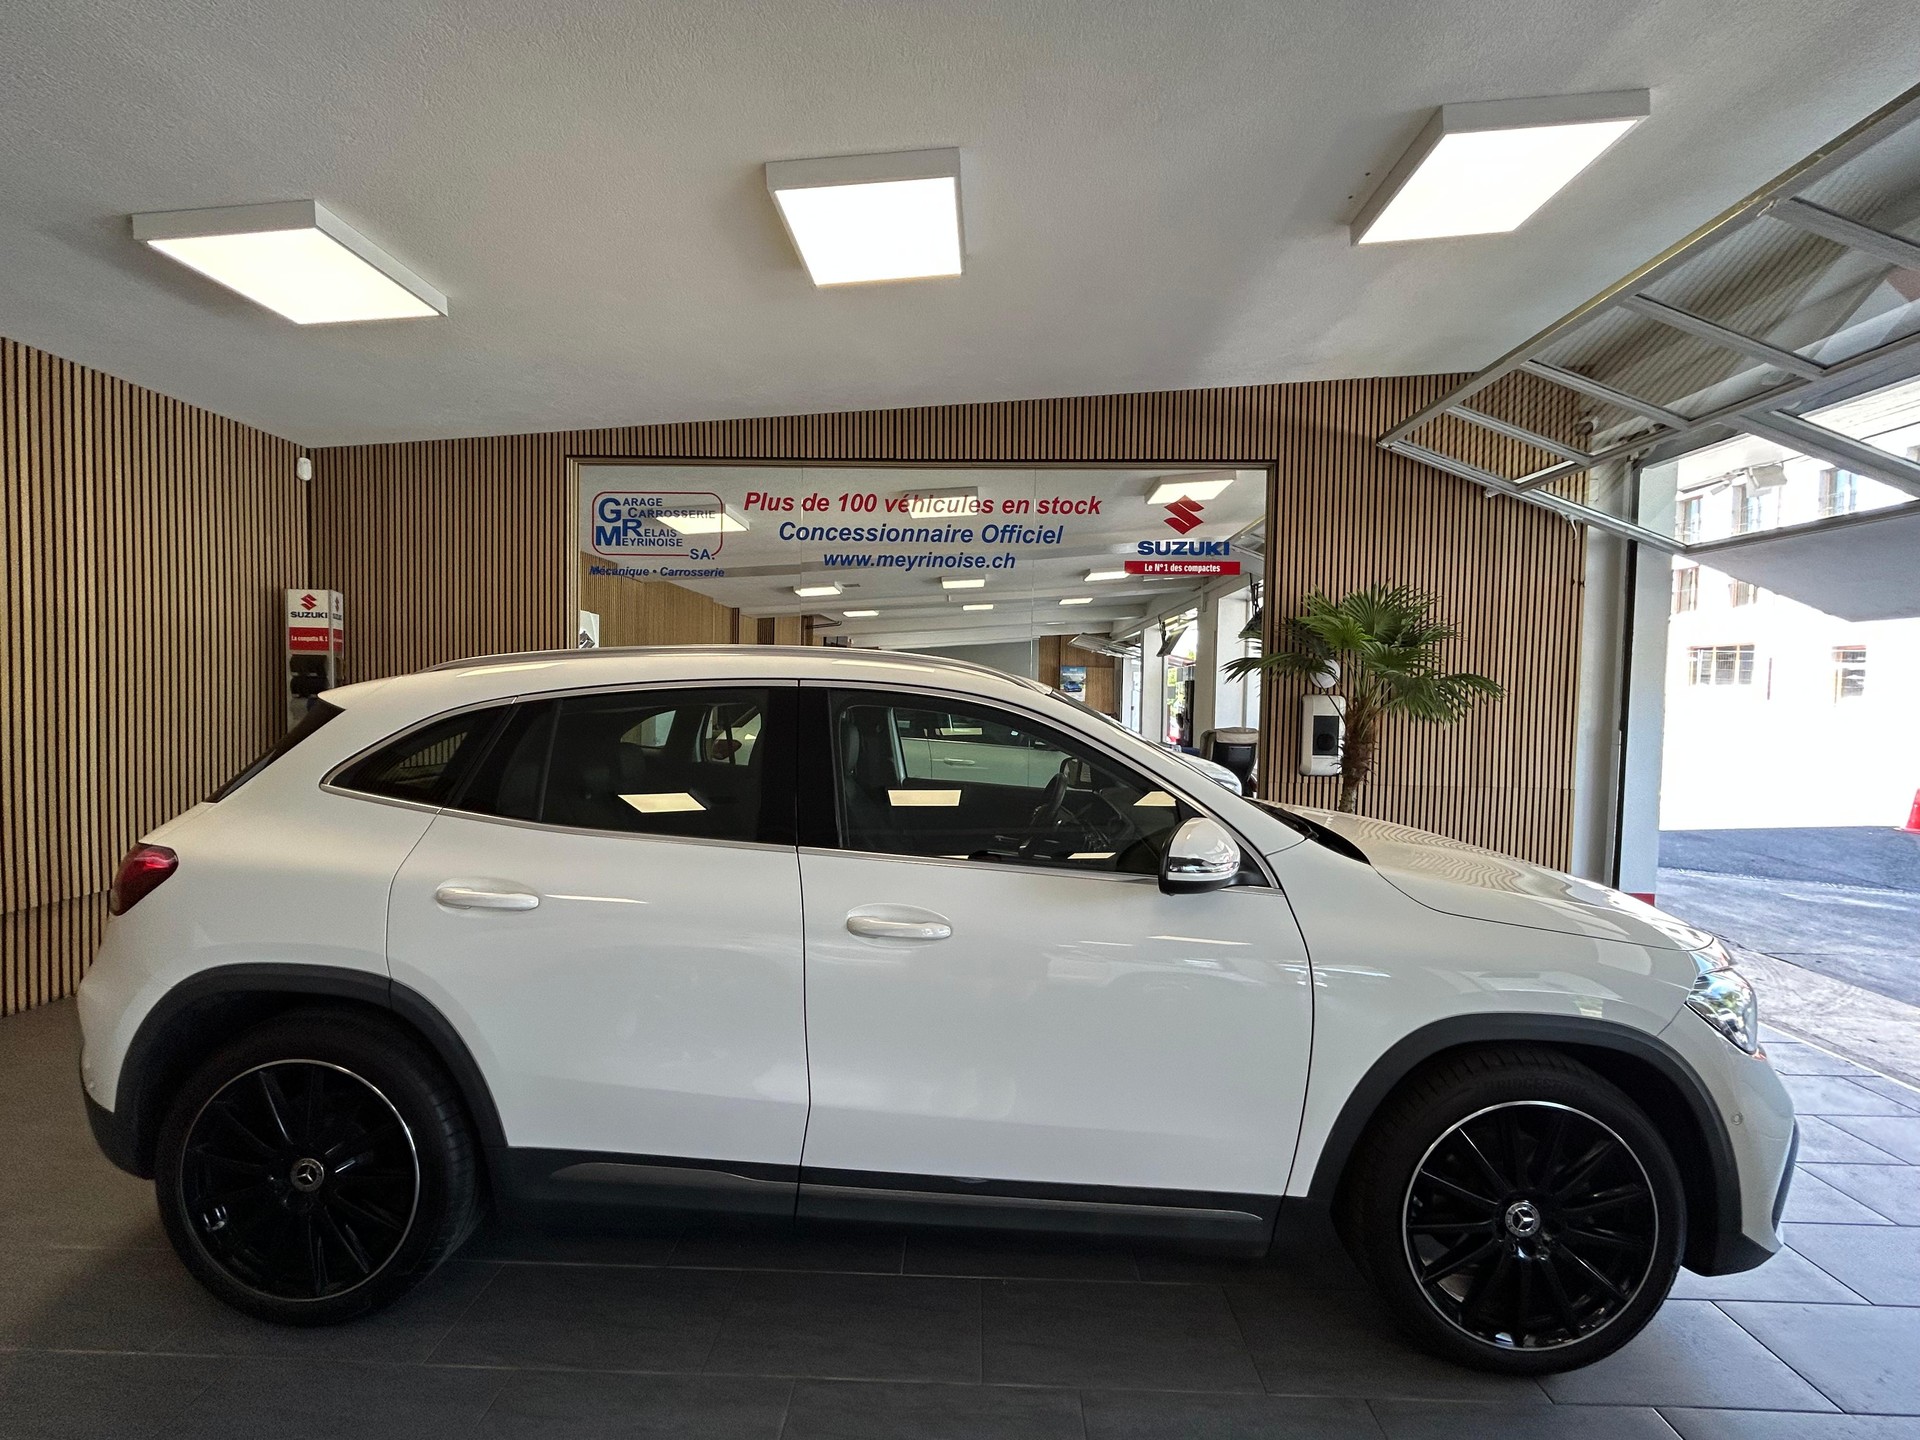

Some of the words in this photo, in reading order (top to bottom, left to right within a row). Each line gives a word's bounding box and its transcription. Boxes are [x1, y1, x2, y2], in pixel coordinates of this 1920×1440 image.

[627, 507, 716, 519] CARROSSERIE
[743, 492, 795, 511] Plus
[801, 493, 830, 512] de
[838, 493, 878, 512] 100
[885, 493, 995, 514] véhicules
[1002, 498, 1030, 514] en
[1036, 496, 1103, 515] stock
[595, 525, 683, 547] MEYRINOISE
[622, 518, 677, 538] RELAIS
[779, 521, 974, 543] Concessionnaire
[981, 524, 1064, 545] Officiel
[1137, 540, 1230, 556] SUZUKI
[589, 565, 650, 577] Mécanique
[660, 566, 725, 577] Carrosserie
[823, 552, 1016, 572] www.meyrinoise.ch
[1144, 563, 1153, 572] Le
[1170, 563, 1183, 572] des
[1183, 564, 1221, 574] compactes
